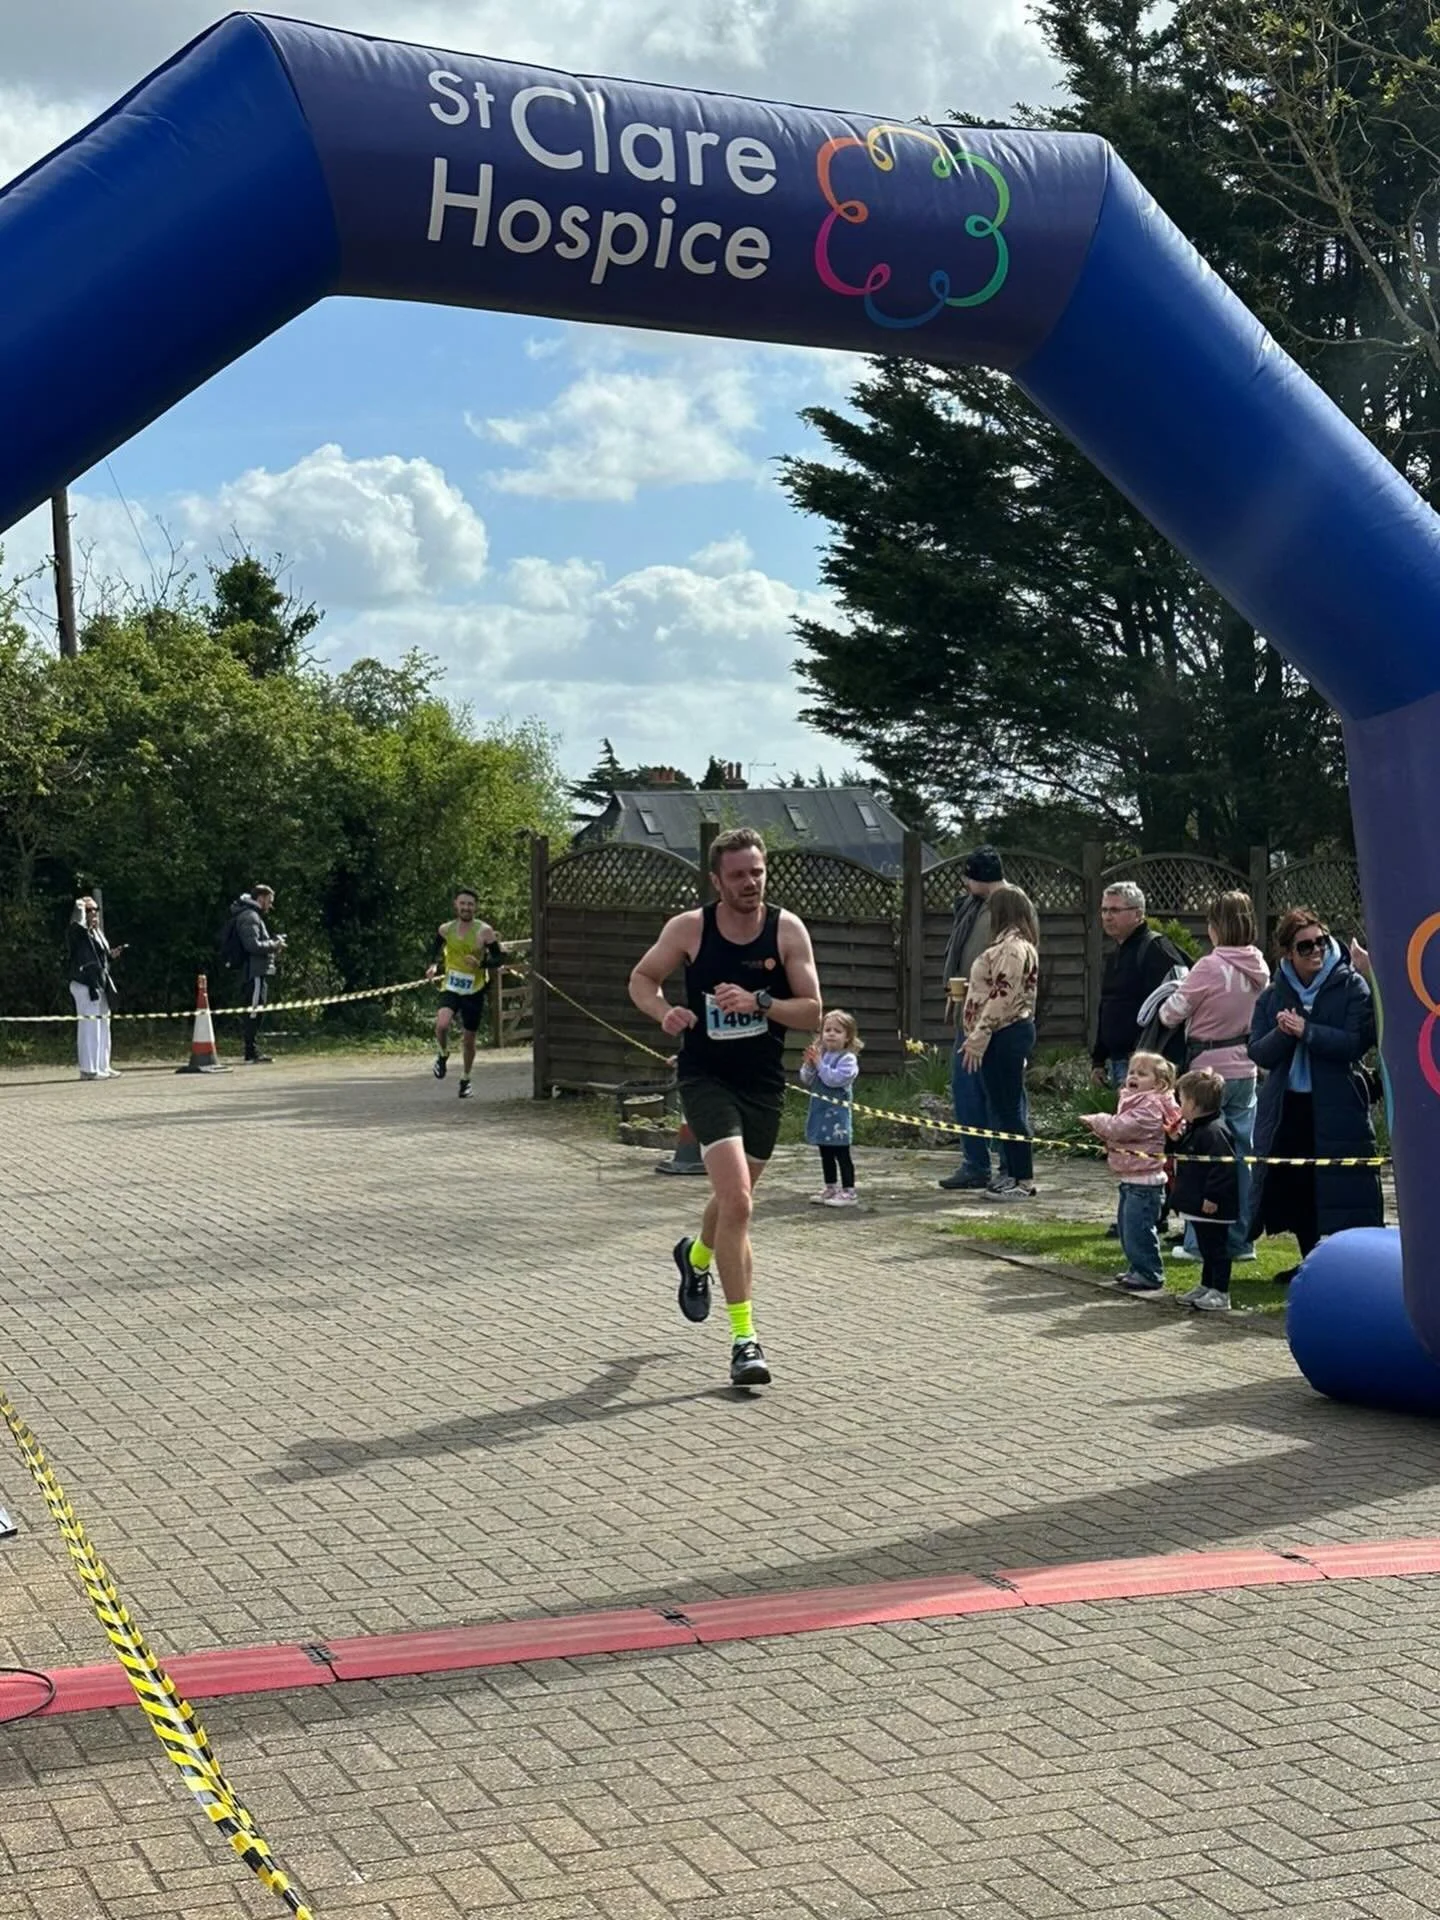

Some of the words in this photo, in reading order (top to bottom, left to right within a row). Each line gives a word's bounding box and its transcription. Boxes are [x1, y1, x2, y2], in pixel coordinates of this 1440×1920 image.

[428, 69, 495, 130] St
[510, 85, 778, 195] Clare
[426, 156, 772, 285] Hospice
